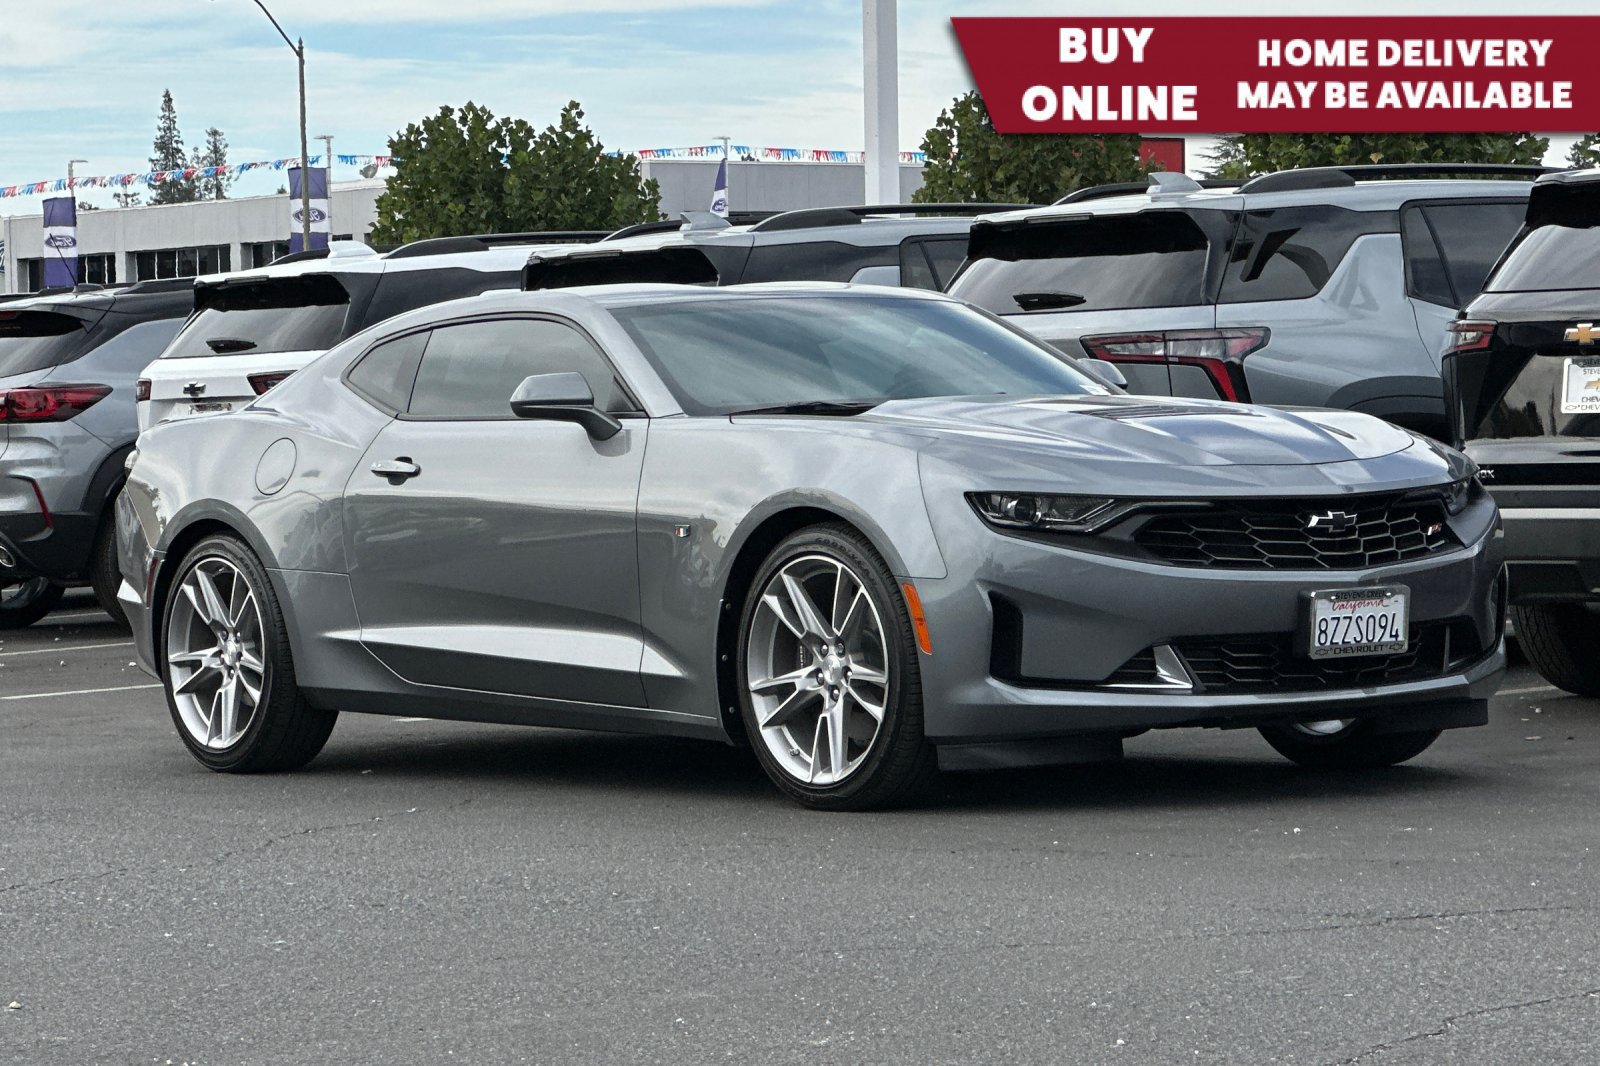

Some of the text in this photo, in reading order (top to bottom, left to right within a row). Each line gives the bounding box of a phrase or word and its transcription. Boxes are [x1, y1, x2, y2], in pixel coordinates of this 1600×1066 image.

[1335, 591, 1365, 599] STEVENS
[1331, 598, 1390, 614] California
[1317, 614, 1400, 646] 8ZZS094
[1333, 644, 1384, 655] CHEVROLET
